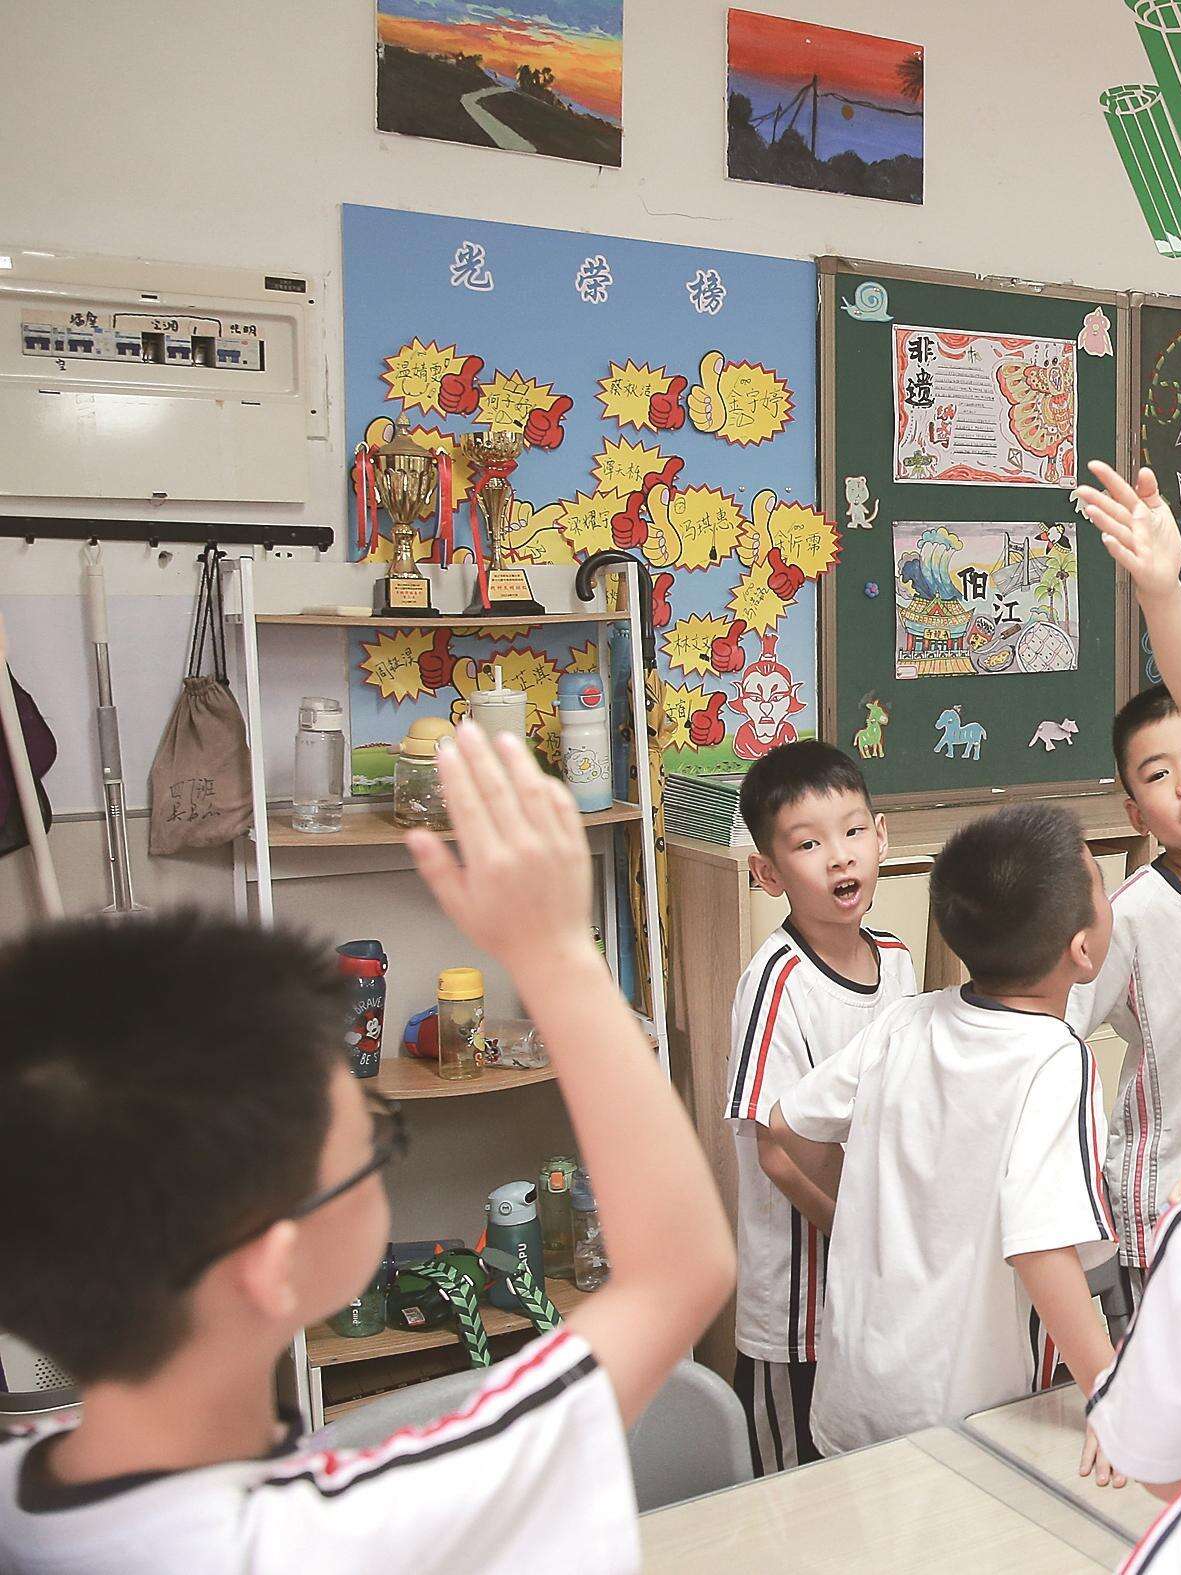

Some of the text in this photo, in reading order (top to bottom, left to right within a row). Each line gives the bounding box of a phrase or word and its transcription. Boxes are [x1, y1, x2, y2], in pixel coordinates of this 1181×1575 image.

[450, 239, 728, 316] 光荣榜
[905, 336, 936, 409] 非遗
[957, 565, 1023, 626] 阳江
